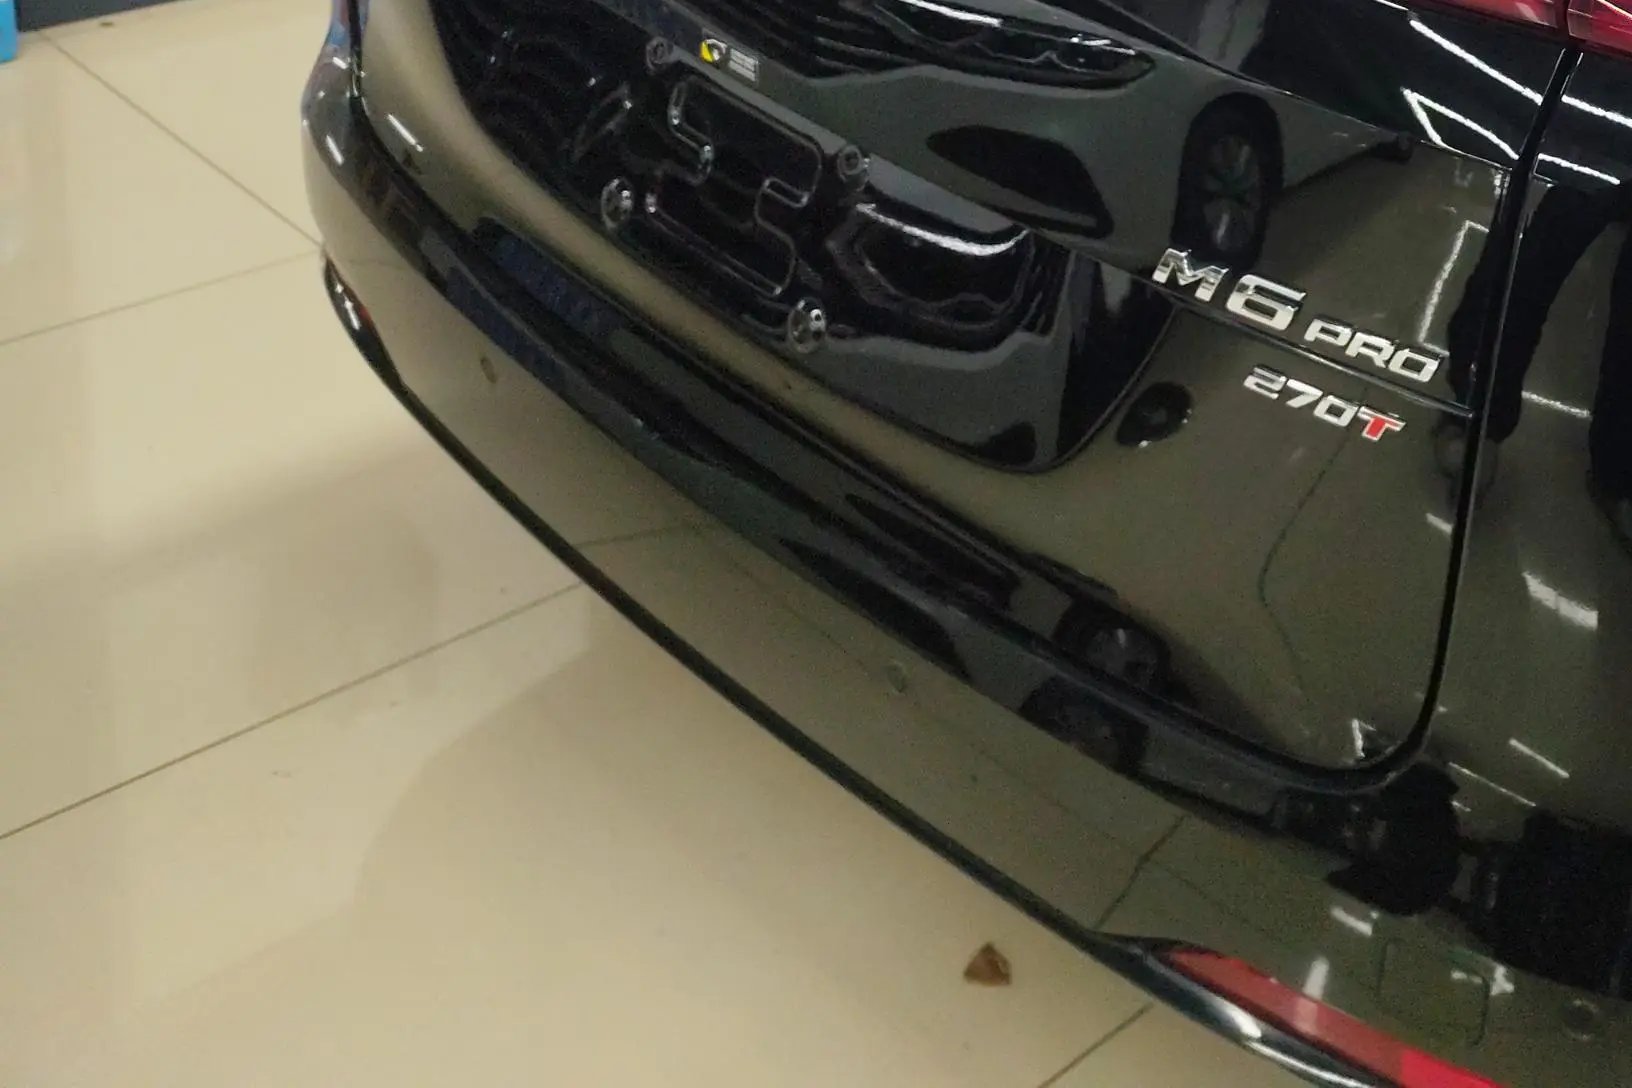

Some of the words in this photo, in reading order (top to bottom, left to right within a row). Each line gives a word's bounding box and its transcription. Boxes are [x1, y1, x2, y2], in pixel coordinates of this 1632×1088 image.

[1151, 247, 1307, 332] M6
[1303, 316, 1443, 383] PRO
[1242, 362, 1407, 442] 270T
